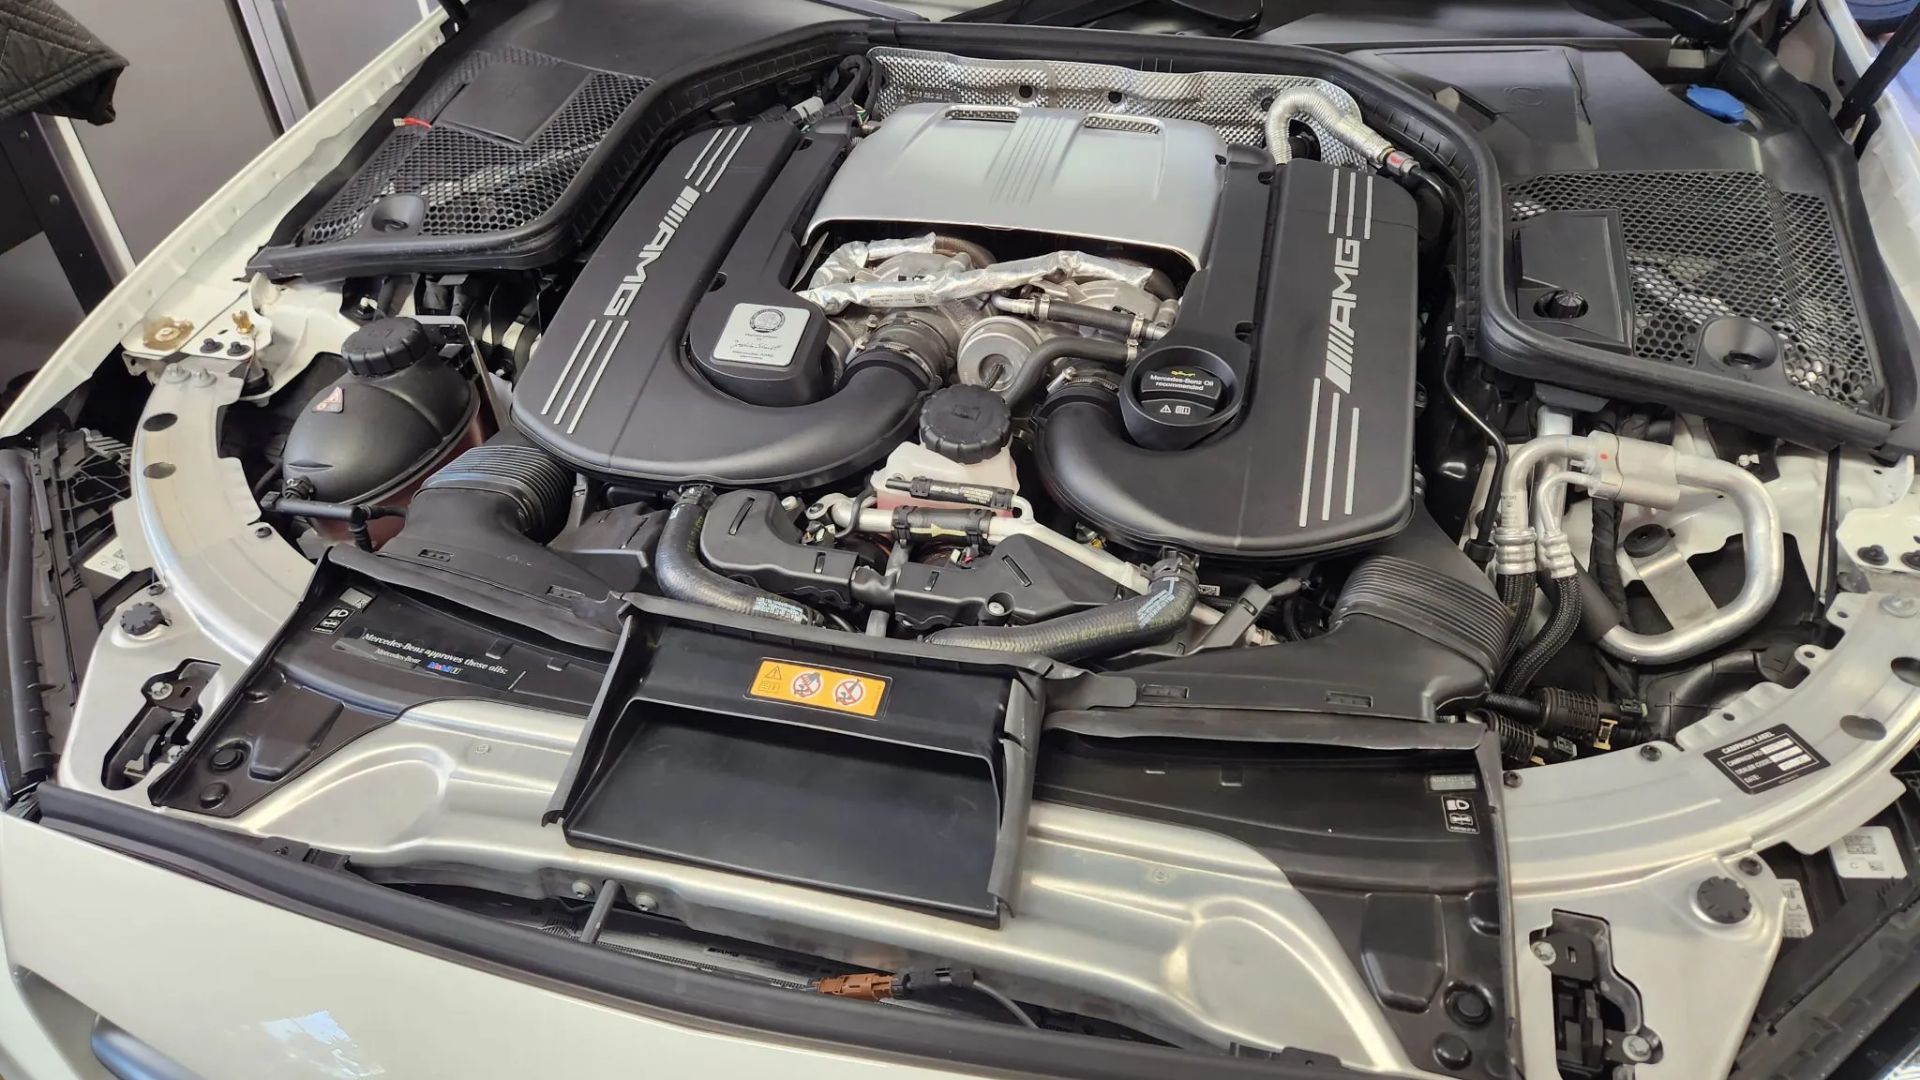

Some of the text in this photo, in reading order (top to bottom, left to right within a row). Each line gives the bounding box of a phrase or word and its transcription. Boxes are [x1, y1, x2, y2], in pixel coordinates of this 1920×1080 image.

[604, 221, 676, 316] AMG
[1150, 374, 1202, 386] Mercedes-Benz
[1155, 382, 1204, 391] recommended
[362, 632, 509, 675] Mercedes-Benz approves these oils:
[374, 647, 422, 664] Mercedes-Benz
[1721, 739, 1755, 754] CAMPAIGN
[1754, 731, 1775, 743] LABEL
[1726, 754, 1754, 767] CAMPAIGN
[1735, 763, 1756, 775] DEALER
[1743, 774, 1760, 784] DATE:
